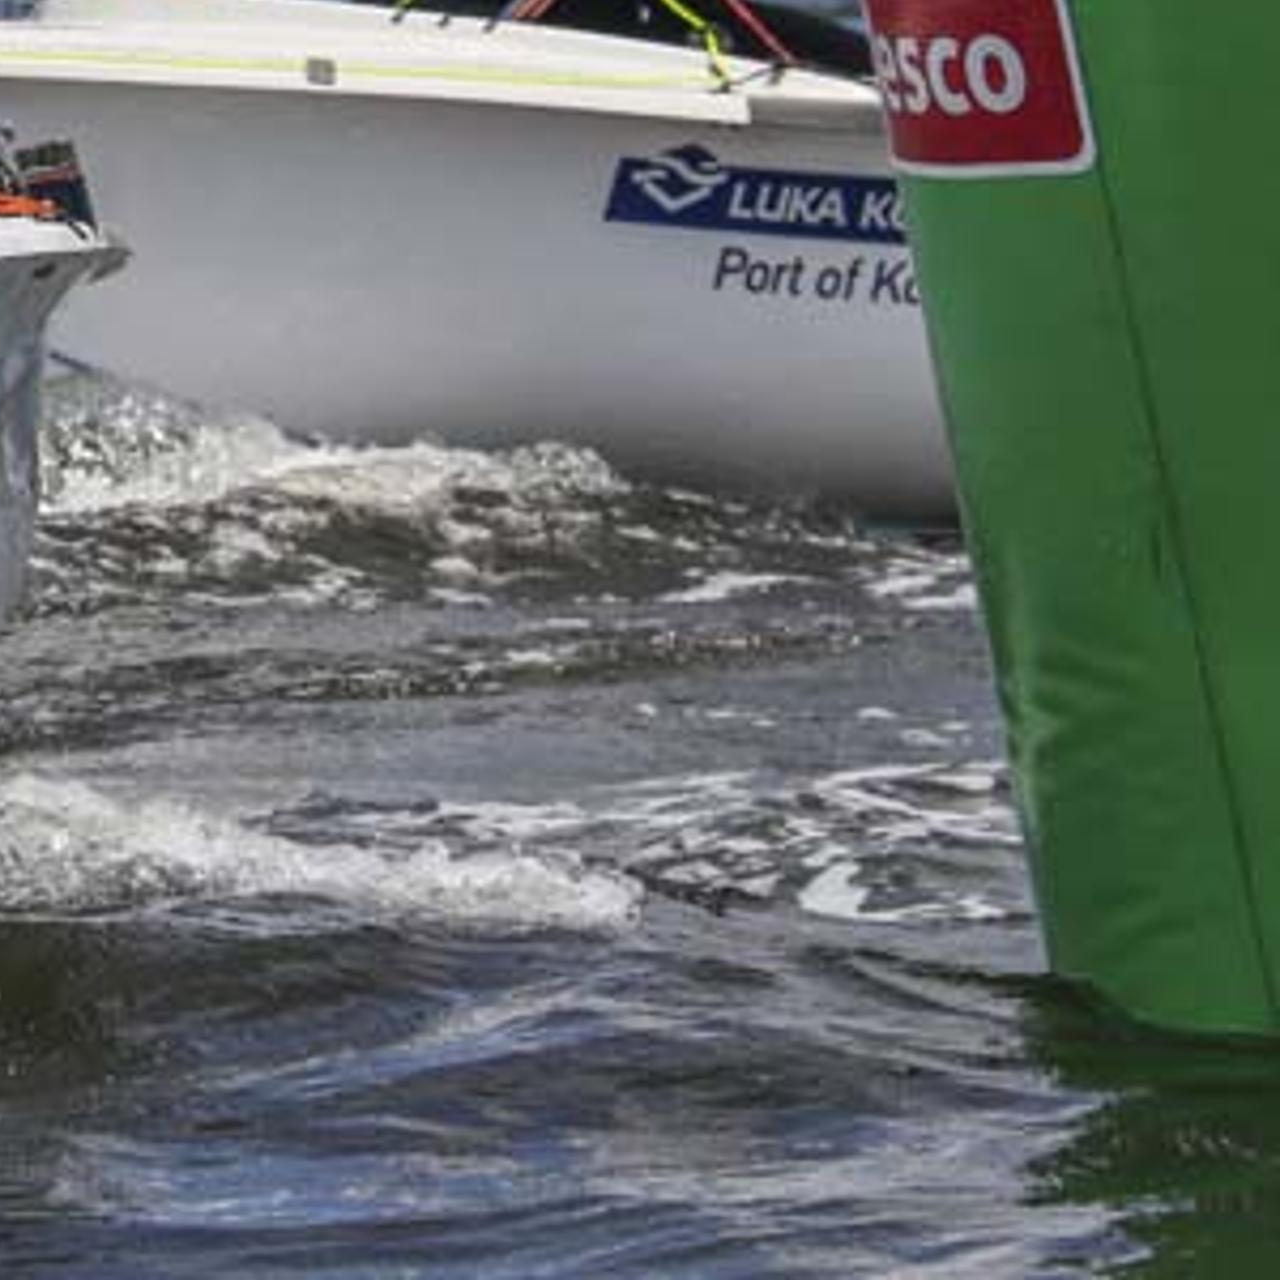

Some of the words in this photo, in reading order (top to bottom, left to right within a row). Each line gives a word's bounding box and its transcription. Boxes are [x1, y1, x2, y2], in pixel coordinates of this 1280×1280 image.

[728, 181, 847, 226] LUKA
[712, 246, 804, 296] Port
[815, 256, 865, 302] of
